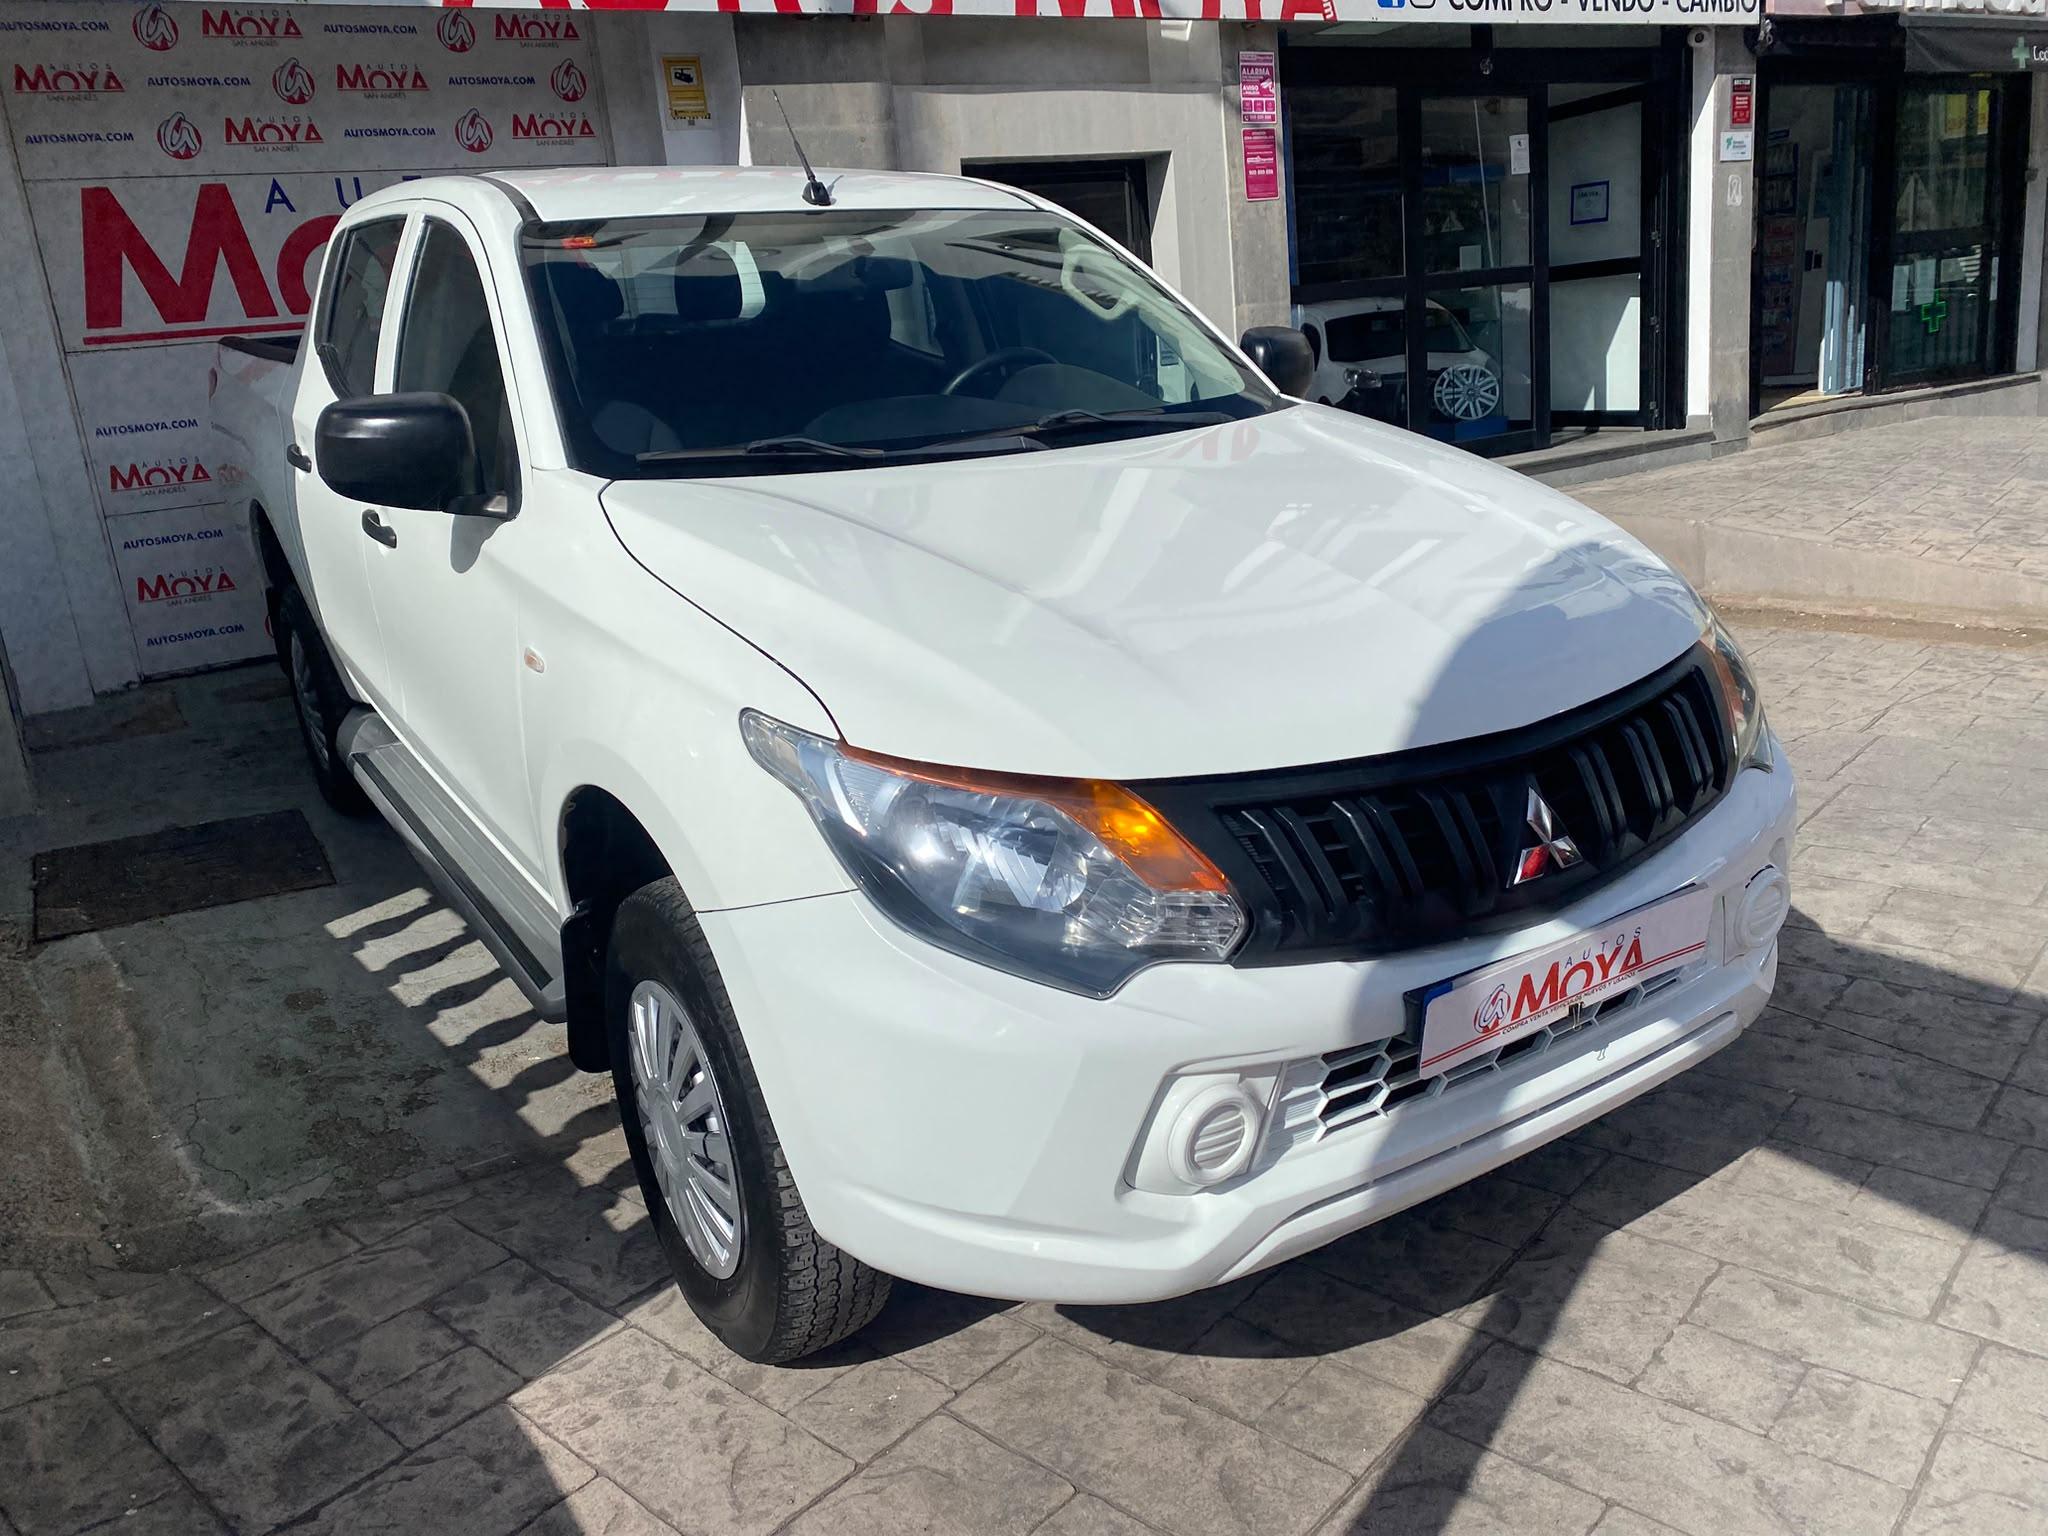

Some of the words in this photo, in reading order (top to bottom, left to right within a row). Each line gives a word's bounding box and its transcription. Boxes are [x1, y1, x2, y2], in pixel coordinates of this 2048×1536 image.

[0, 21, 110, 32] AUTOSMOYA.COM
[202, 9, 303, 36] MOYA
[323, 24, 418, 34] AUTOSMOYA.COM
[495, 14, 580, 38] MOYA
[14, 63, 125, 91] MOYA
[147, 76, 251, 87] AUTOSMOYA.COM
[336, 64, 428, 89] MOYA
[448, 76, 536, 86] AUTOSMOYA.COM
[1242, 67, 1270, 76] ALARMA
[225, 117, 323, 142] MOYA
[344, 127, 436, 138] AUTOSMOYA.COM
[512, 113, 595, 137] MOYA
[25, 131, 135, 144] AUTOSMOYA.COM
[95, 418, 199, 438] AUTOSMOYA.COM
[110, 463, 211, 490] MOYA
[123, 529, 224, 550] AUTOSMOYA.COM
[137, 572, 236, 601] MOYA
[146, 623, 245, 647] AUTOSMOYA.COM
[1564, 926, 1641, 969] AUTOS
[1510, 937, 1644, 1022] MOYA
[1502, 1020, 1529, 1035] COMPRA
[1529, 1010, 1549, 1022] VENTA
